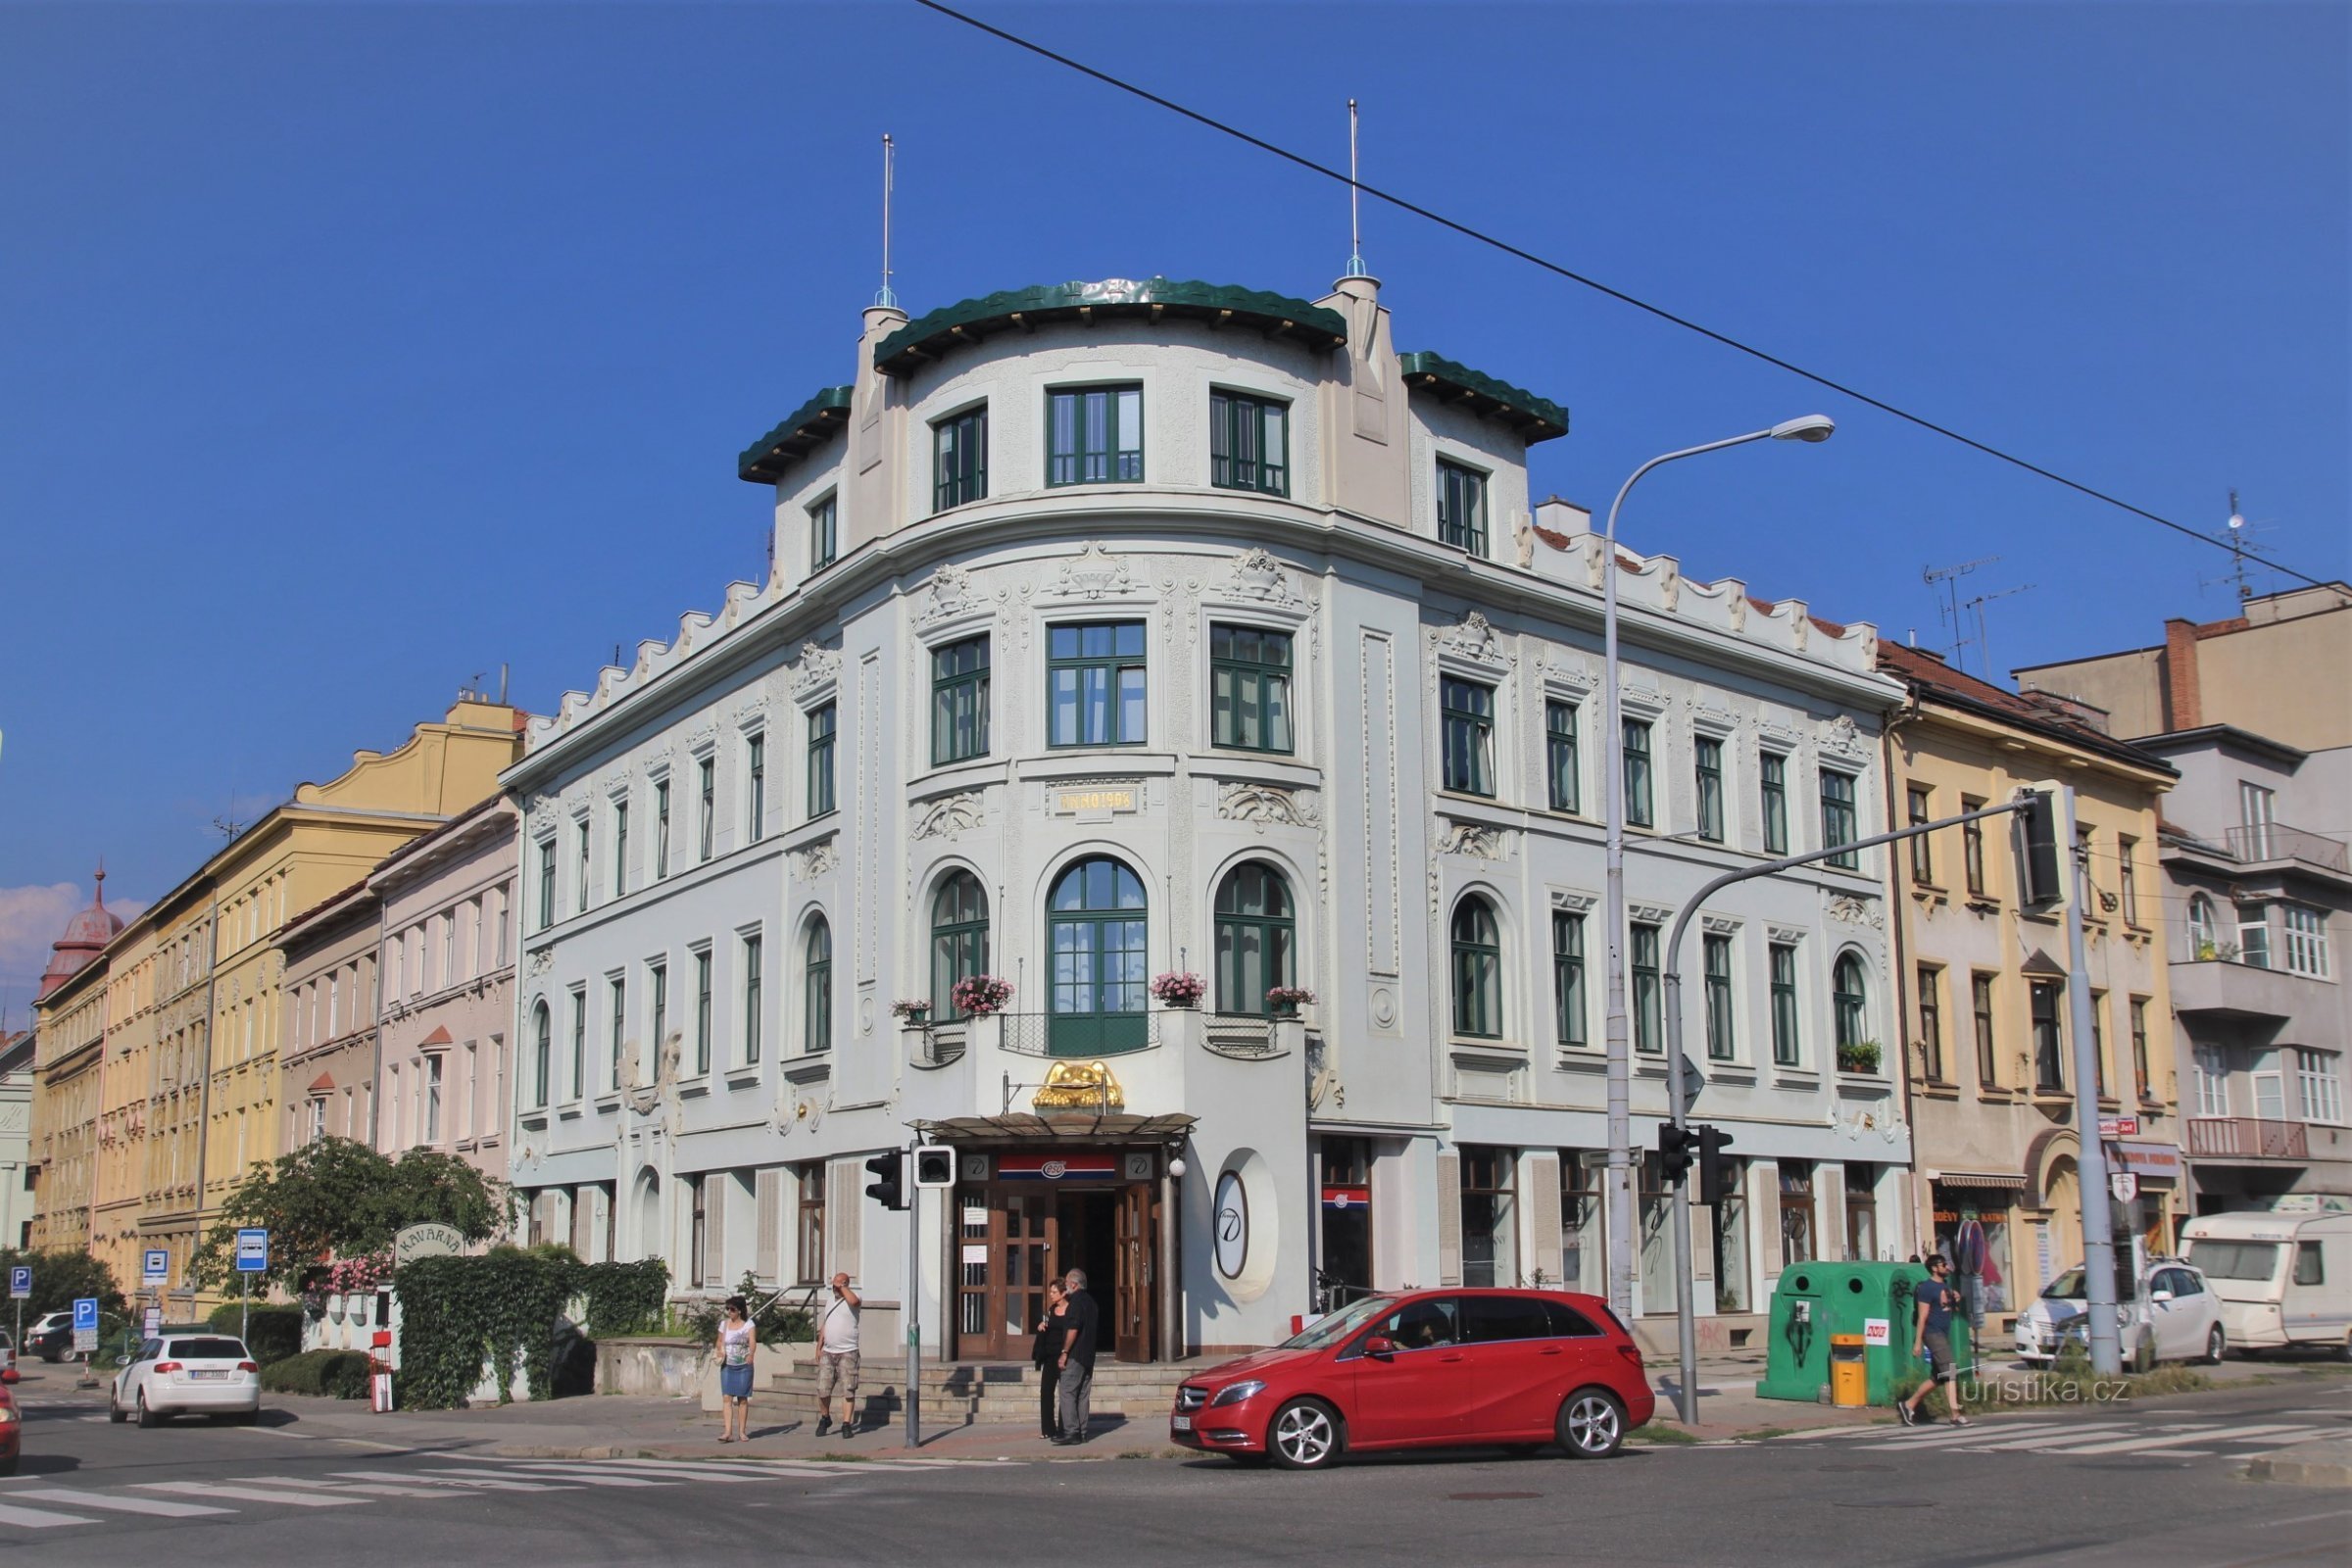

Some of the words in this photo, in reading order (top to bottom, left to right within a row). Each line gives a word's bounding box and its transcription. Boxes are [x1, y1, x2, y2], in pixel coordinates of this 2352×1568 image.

[400, 1225, 461, 1252] KAVÁRNA
[16, 1270, 27, 1285] P
[78, 1302, 92, 1321] P
